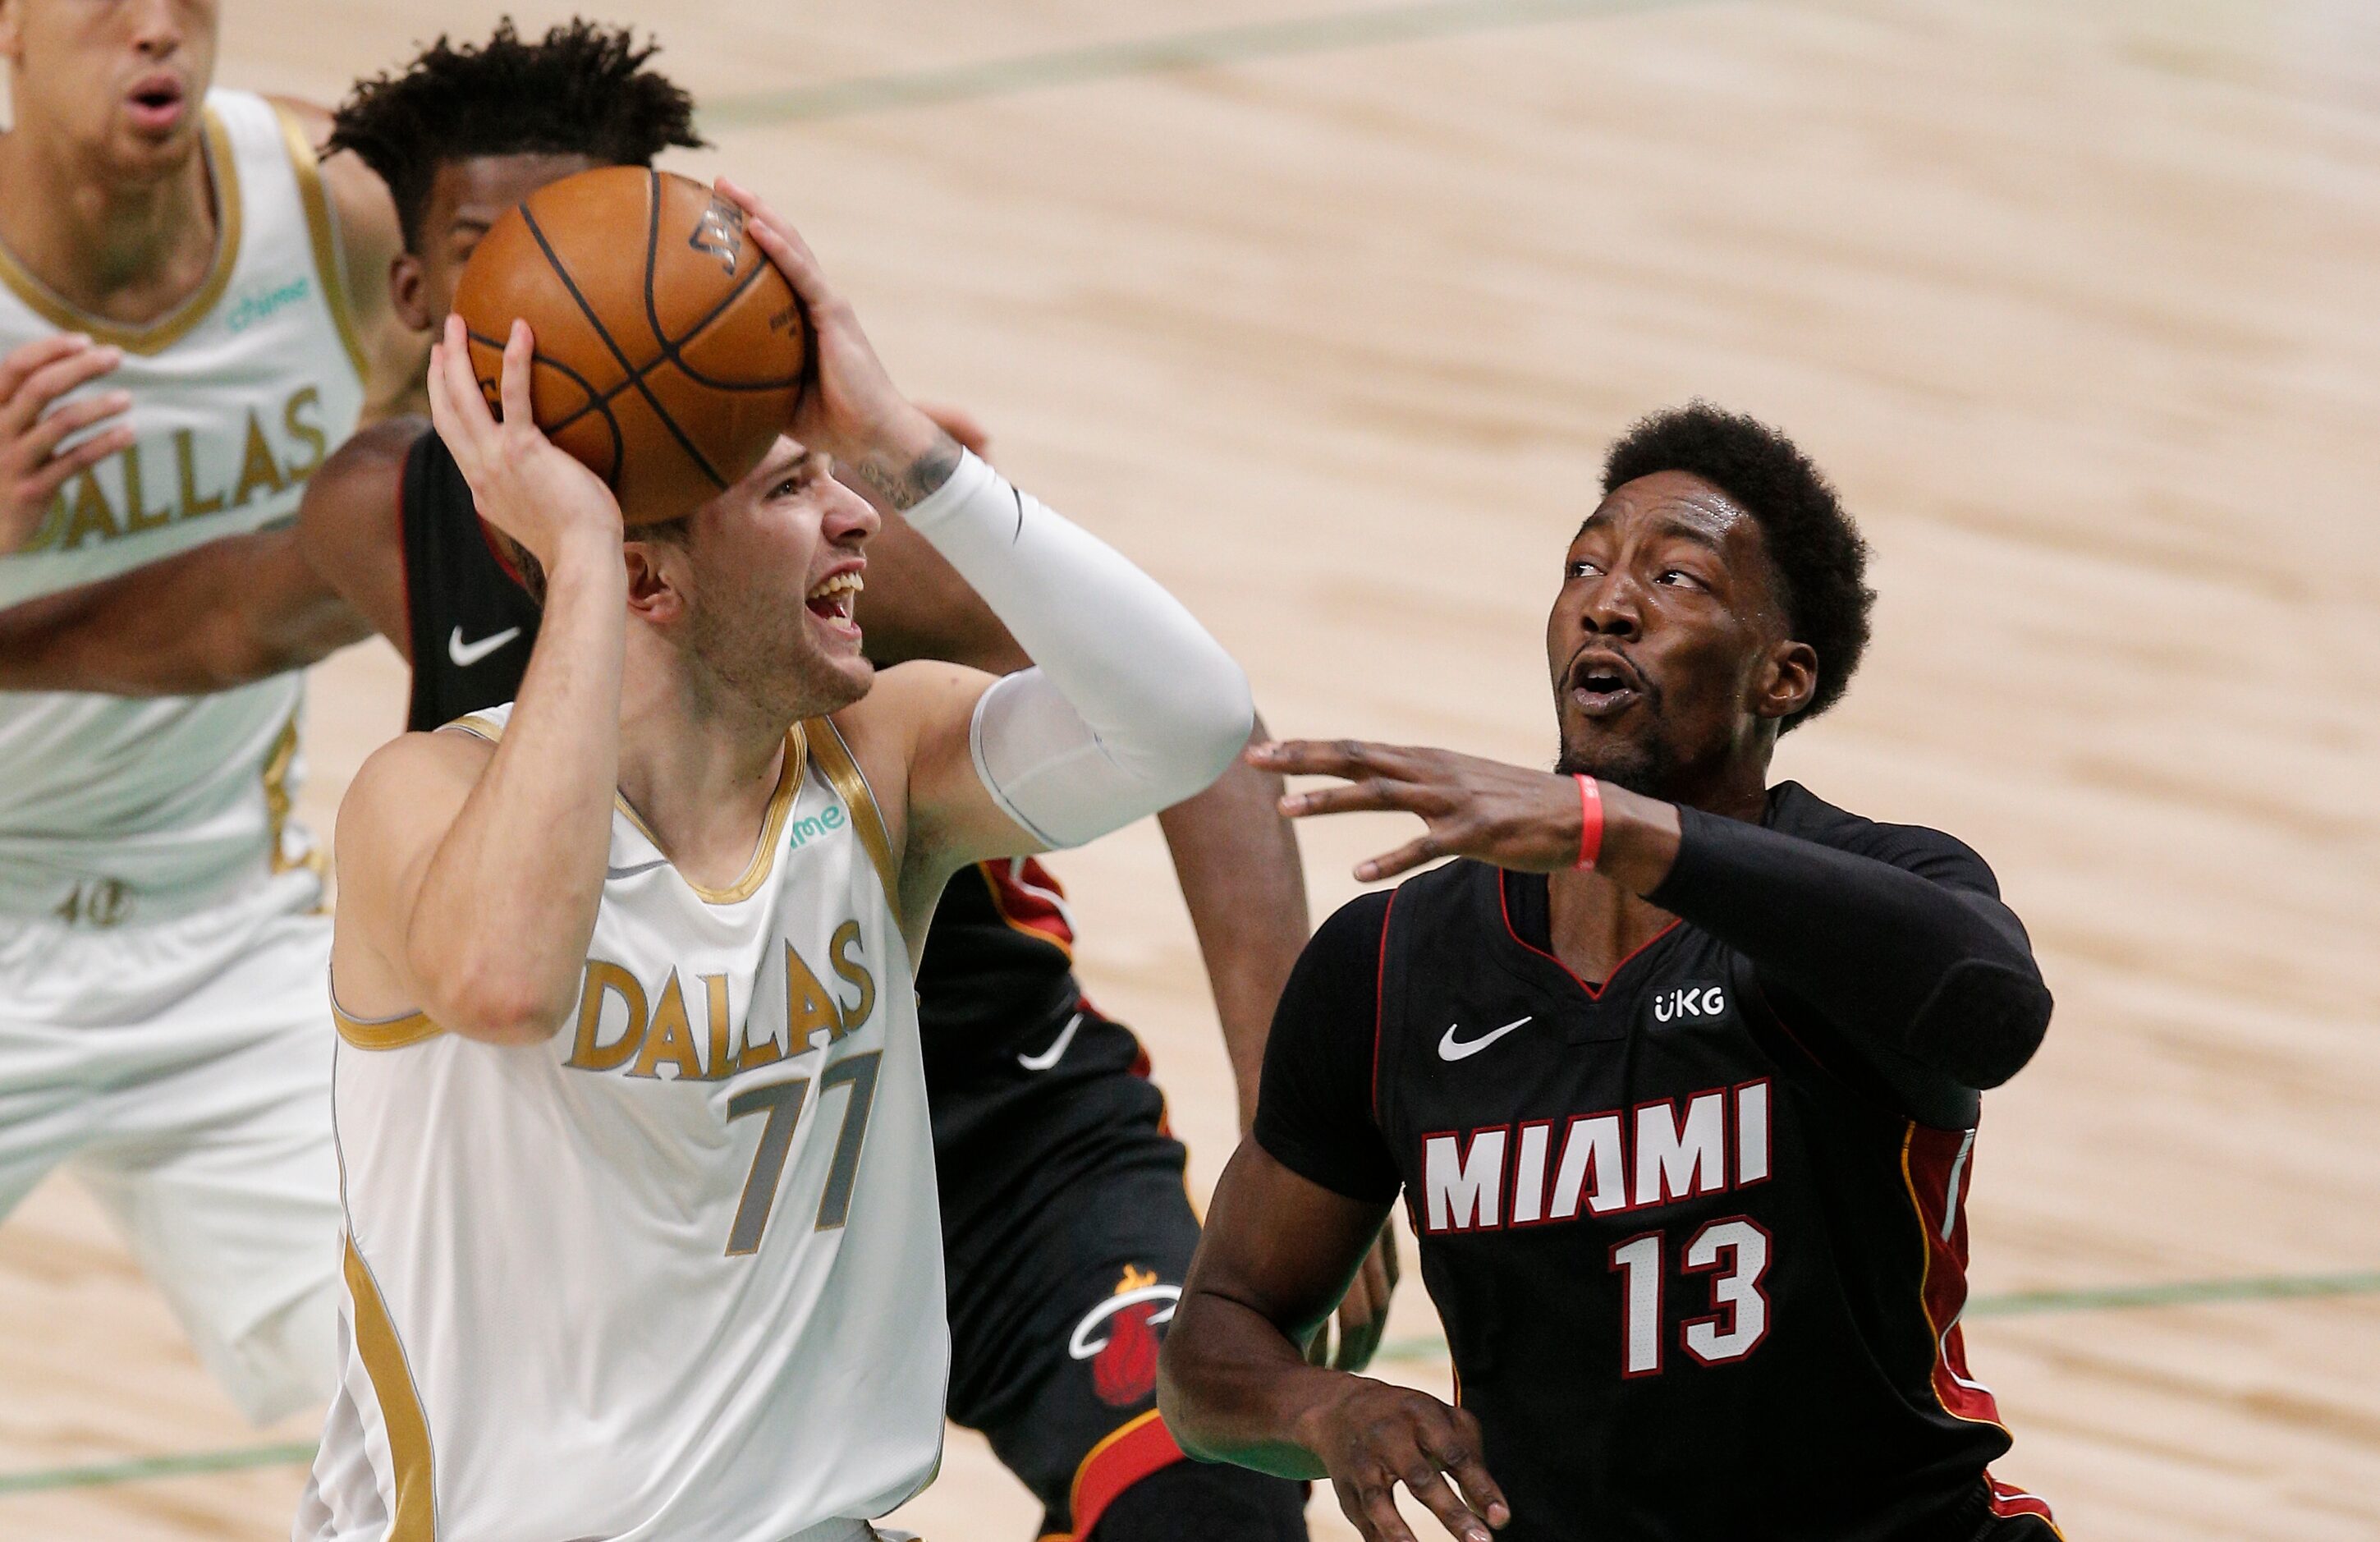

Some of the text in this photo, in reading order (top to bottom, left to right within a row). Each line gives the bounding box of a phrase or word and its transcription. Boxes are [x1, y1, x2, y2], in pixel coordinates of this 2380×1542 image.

[562, 919, 877, 1081] DALLAS
[724, 1049, 883, 1257] 77
[1422, 1076, 1772, 1236] MIAMI
[1608, 1214, 1772, 1379] 13
